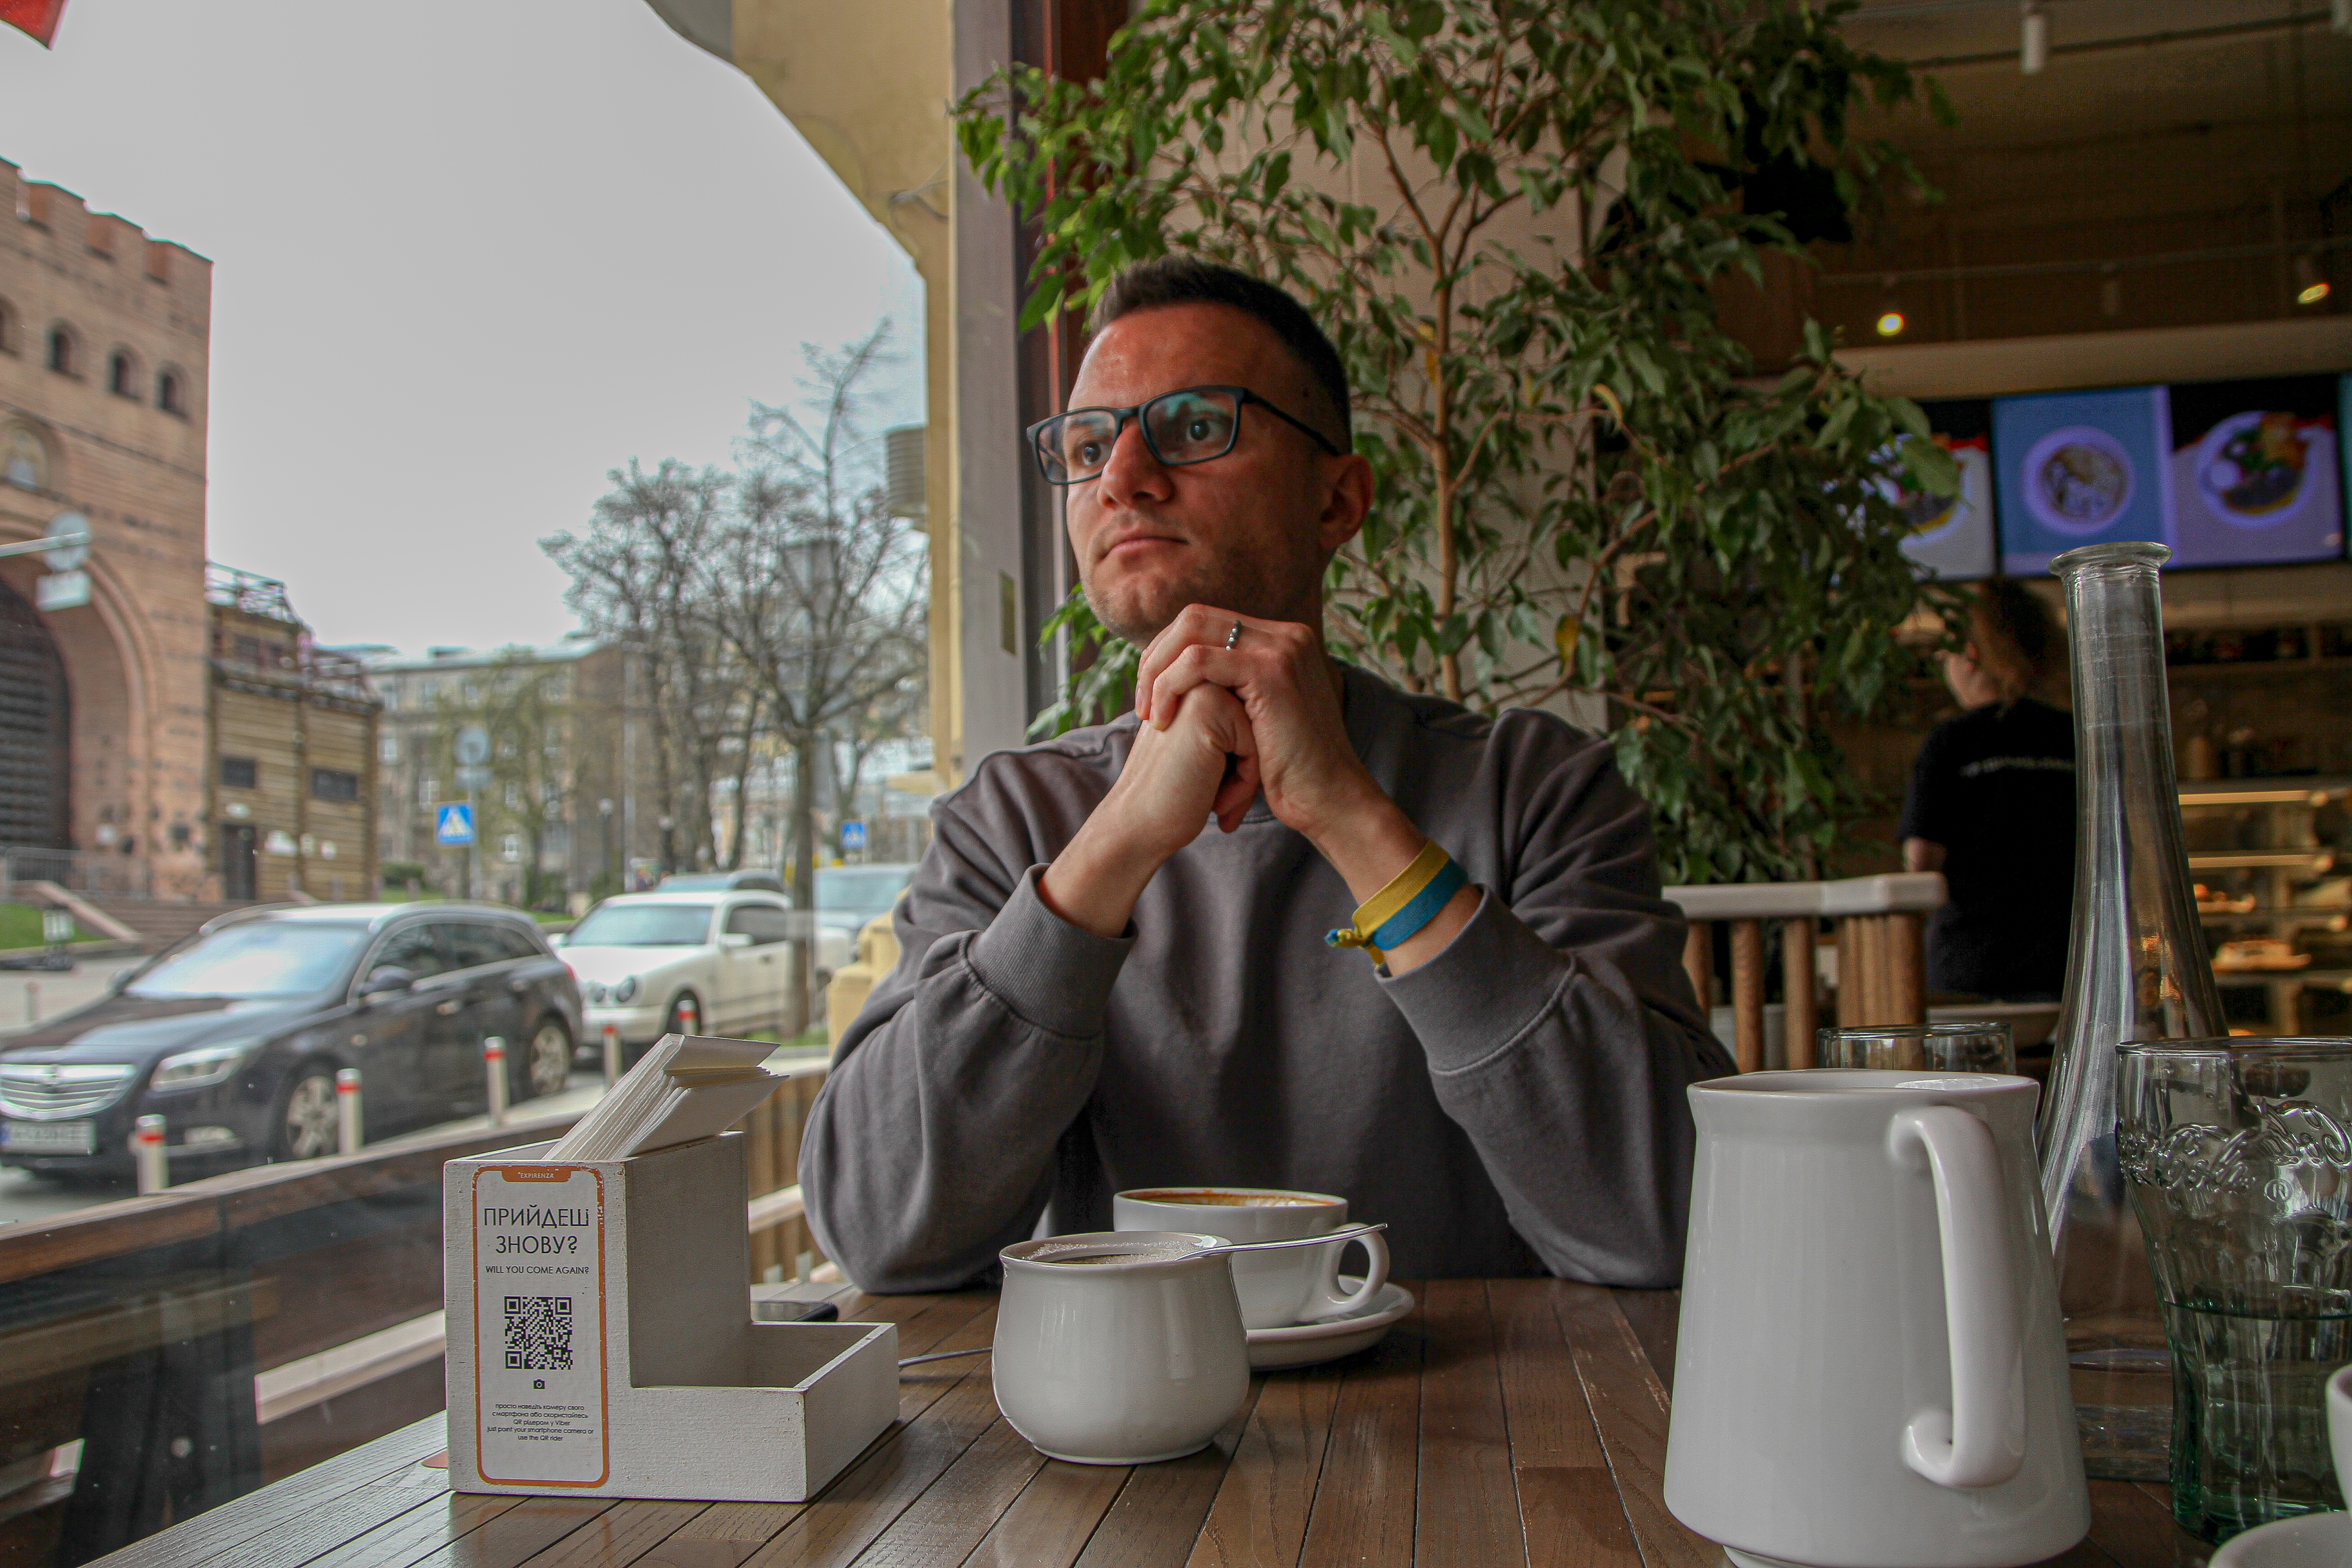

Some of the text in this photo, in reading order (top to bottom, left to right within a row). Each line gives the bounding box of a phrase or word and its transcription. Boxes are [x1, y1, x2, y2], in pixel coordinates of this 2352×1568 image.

[484, 1204, 589, 1229] ПРИЙДЕШ
[495, 1235, 578, 1254] ЗНОВУ?
[485, 1265, 589, 1275] WILL YOU COME AGAIN?
